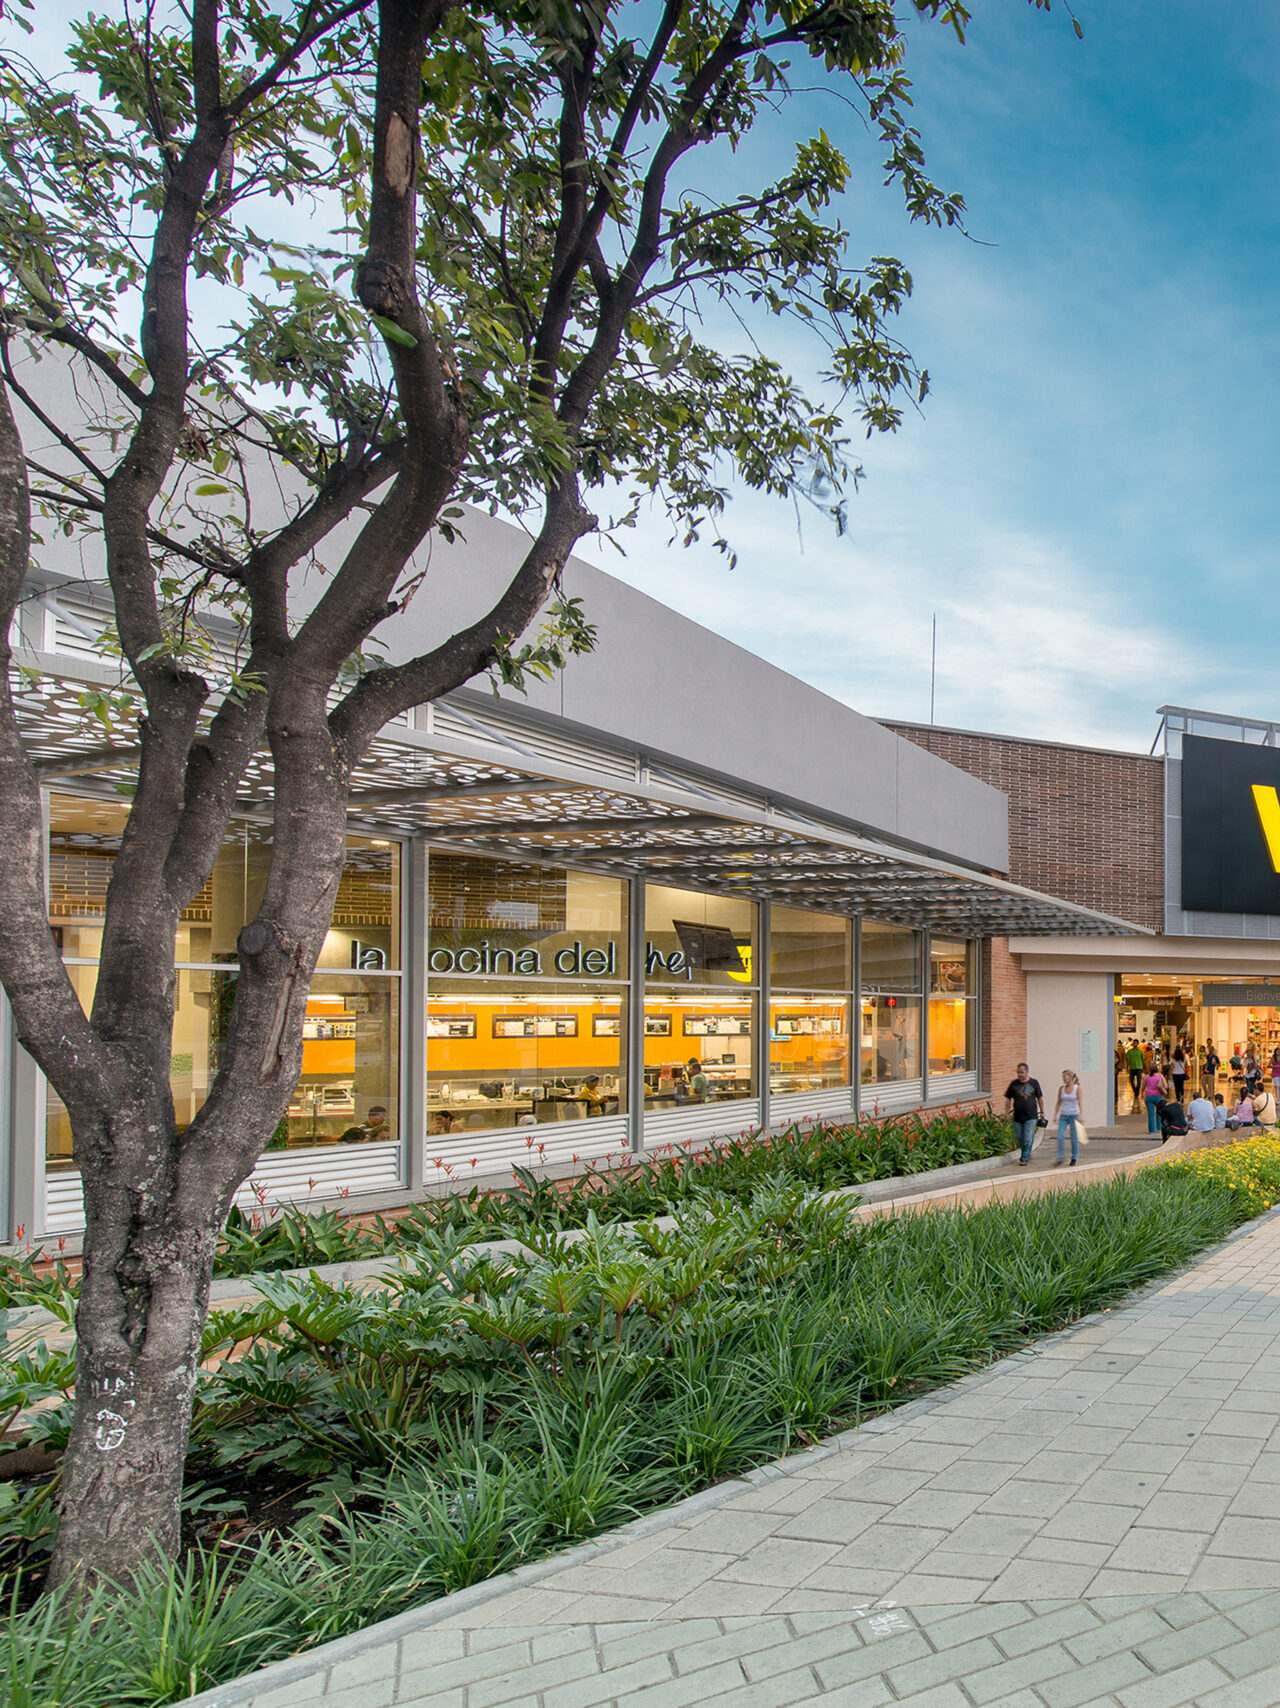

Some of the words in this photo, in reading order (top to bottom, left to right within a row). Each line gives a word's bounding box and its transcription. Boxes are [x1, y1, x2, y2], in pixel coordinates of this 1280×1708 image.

[350, 938, 386, 970] la
[429, 939, 543, 975] ocina
[554, 940, 616, 975] del
